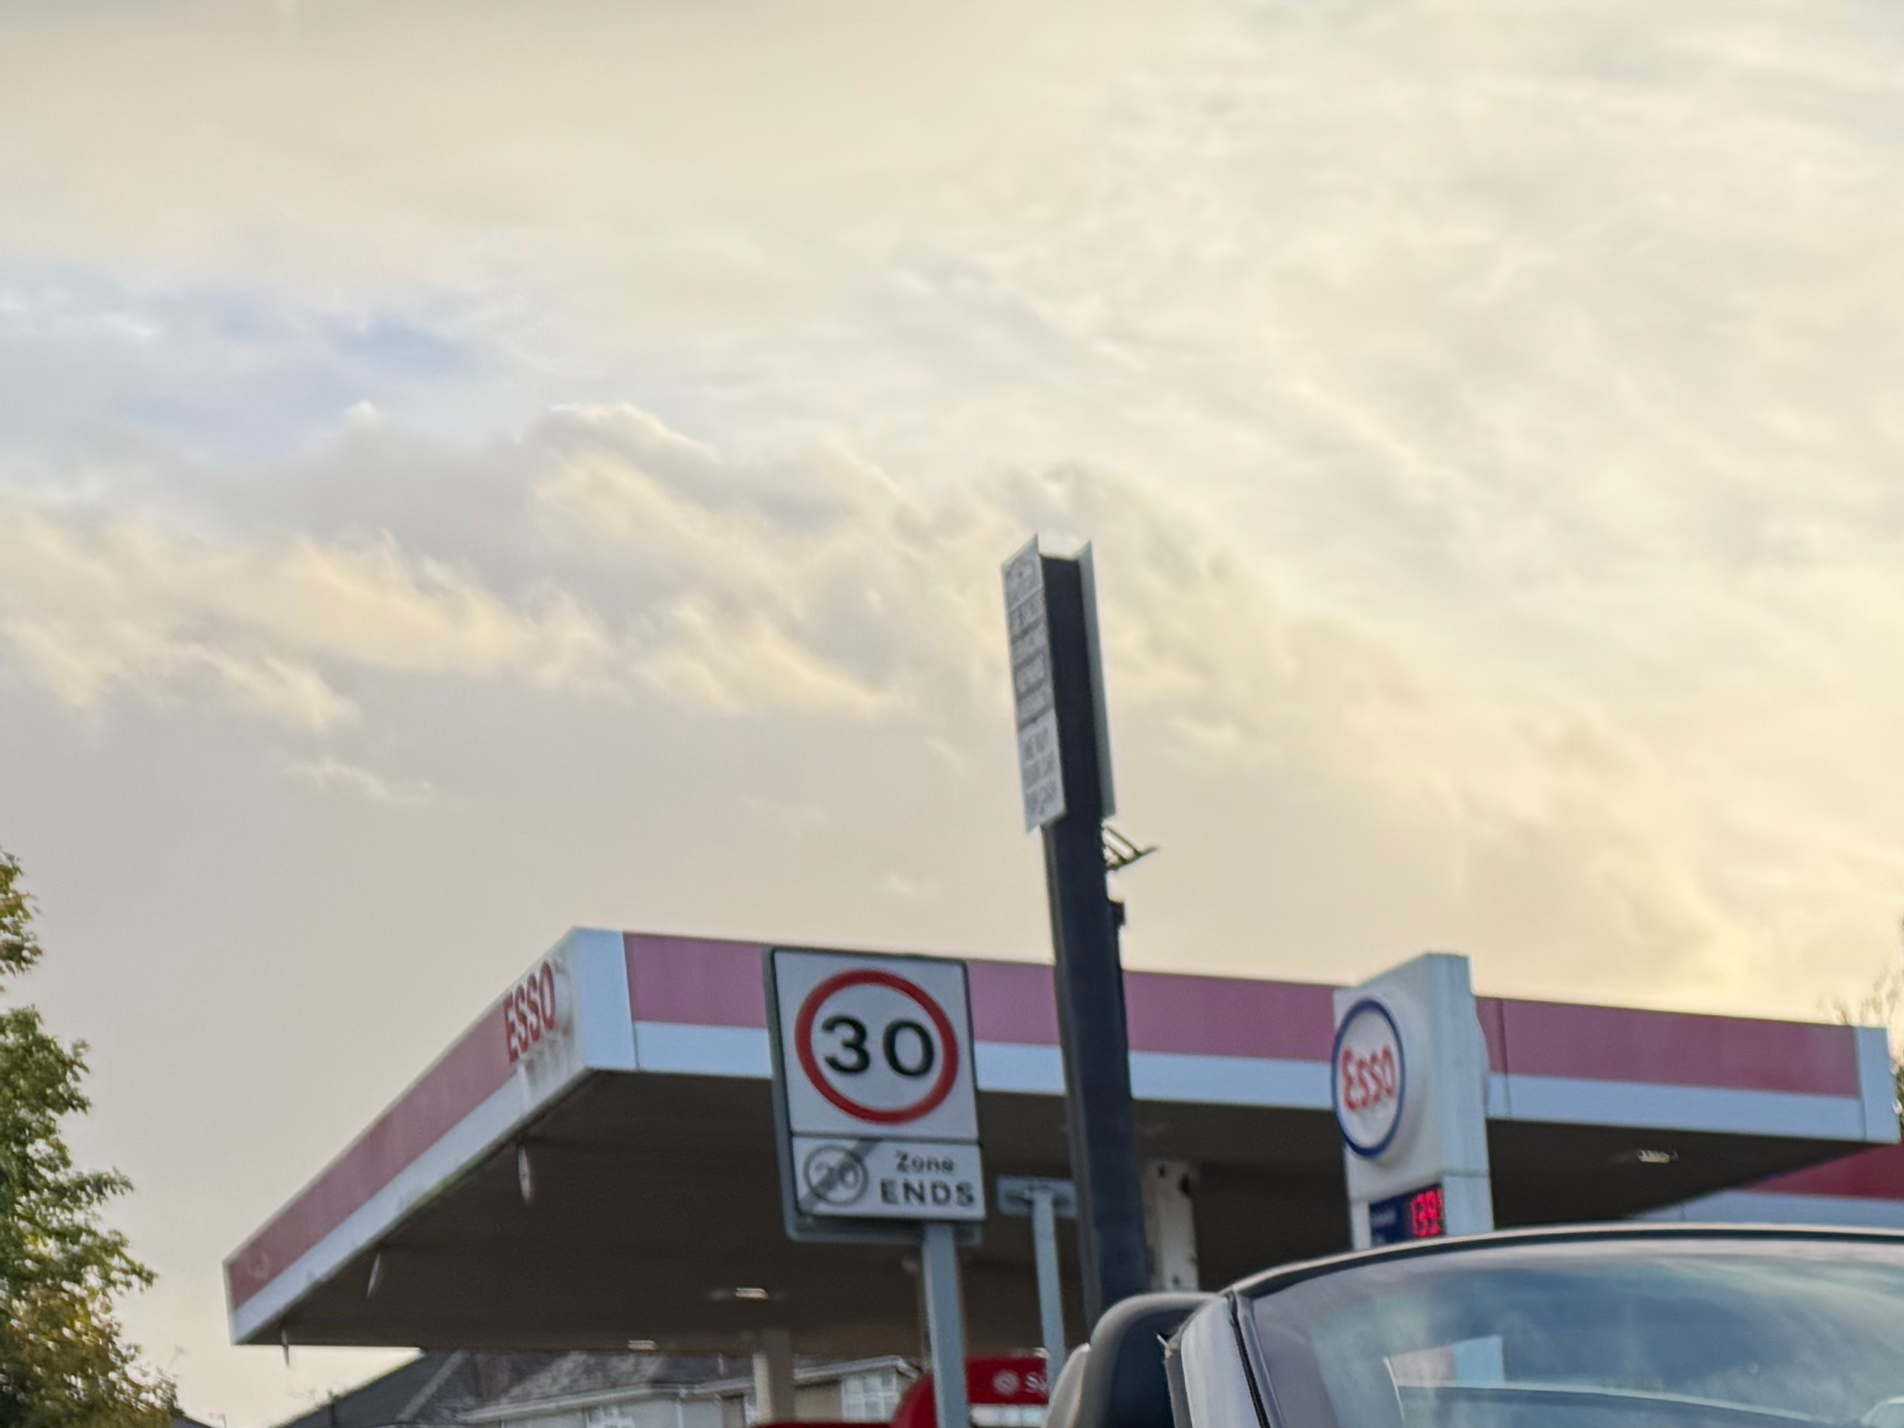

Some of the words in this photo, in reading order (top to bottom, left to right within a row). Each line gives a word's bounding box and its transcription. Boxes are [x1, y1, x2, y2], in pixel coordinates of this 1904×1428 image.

[821, 1015, 935, 1078] 30
[895, 1151, 955, 1173] Zone
[880, 1178, 976, 1207] ENDS
